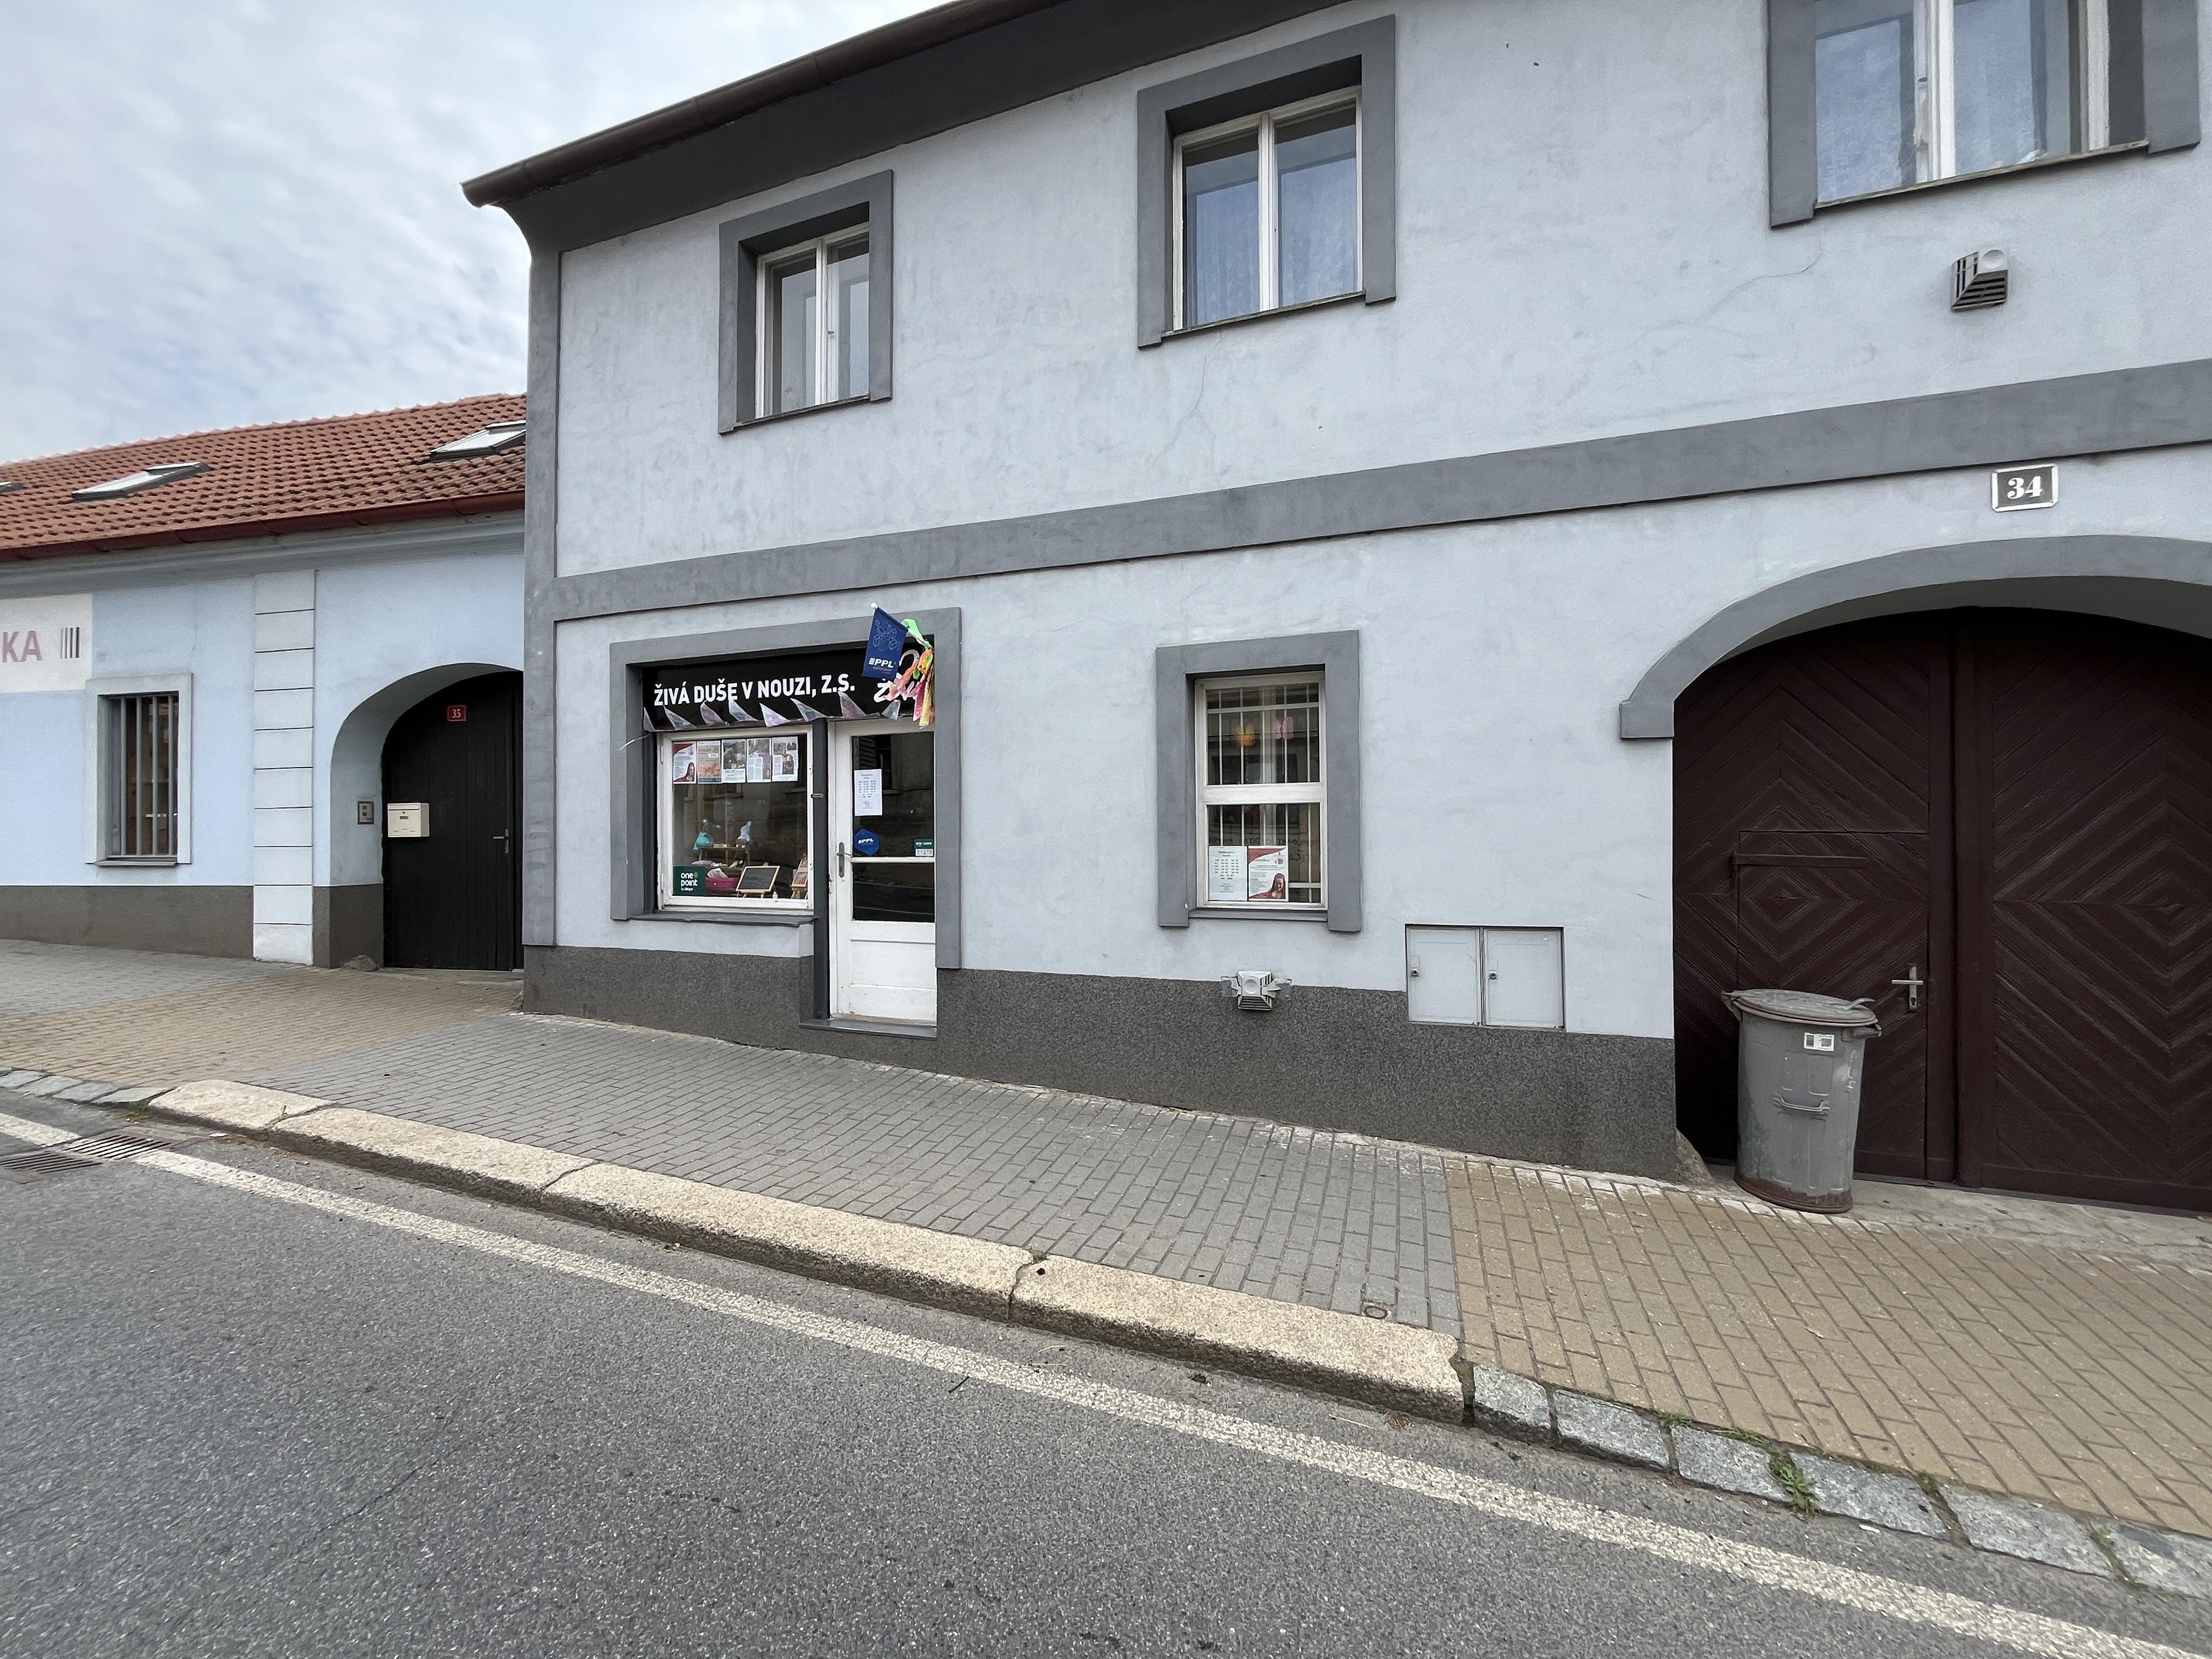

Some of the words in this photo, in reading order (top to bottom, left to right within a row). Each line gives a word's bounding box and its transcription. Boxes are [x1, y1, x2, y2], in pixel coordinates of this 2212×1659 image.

[2007, 476, 2042, 499] 34
[2, 630, 43, 662] KA
[874, 658, 894, 668] PPL
[654, 681, 690, 706] ŽIVÁ
[693, 678, 738, 703] DUŠE
[742, 681, 753, 700] V
[758, 676, 816, 698] NOUZI,
[821, 674, 855, 693] Z.S.
[452, 708, 461, 718] 35
[680, 879, 698, 887] point
